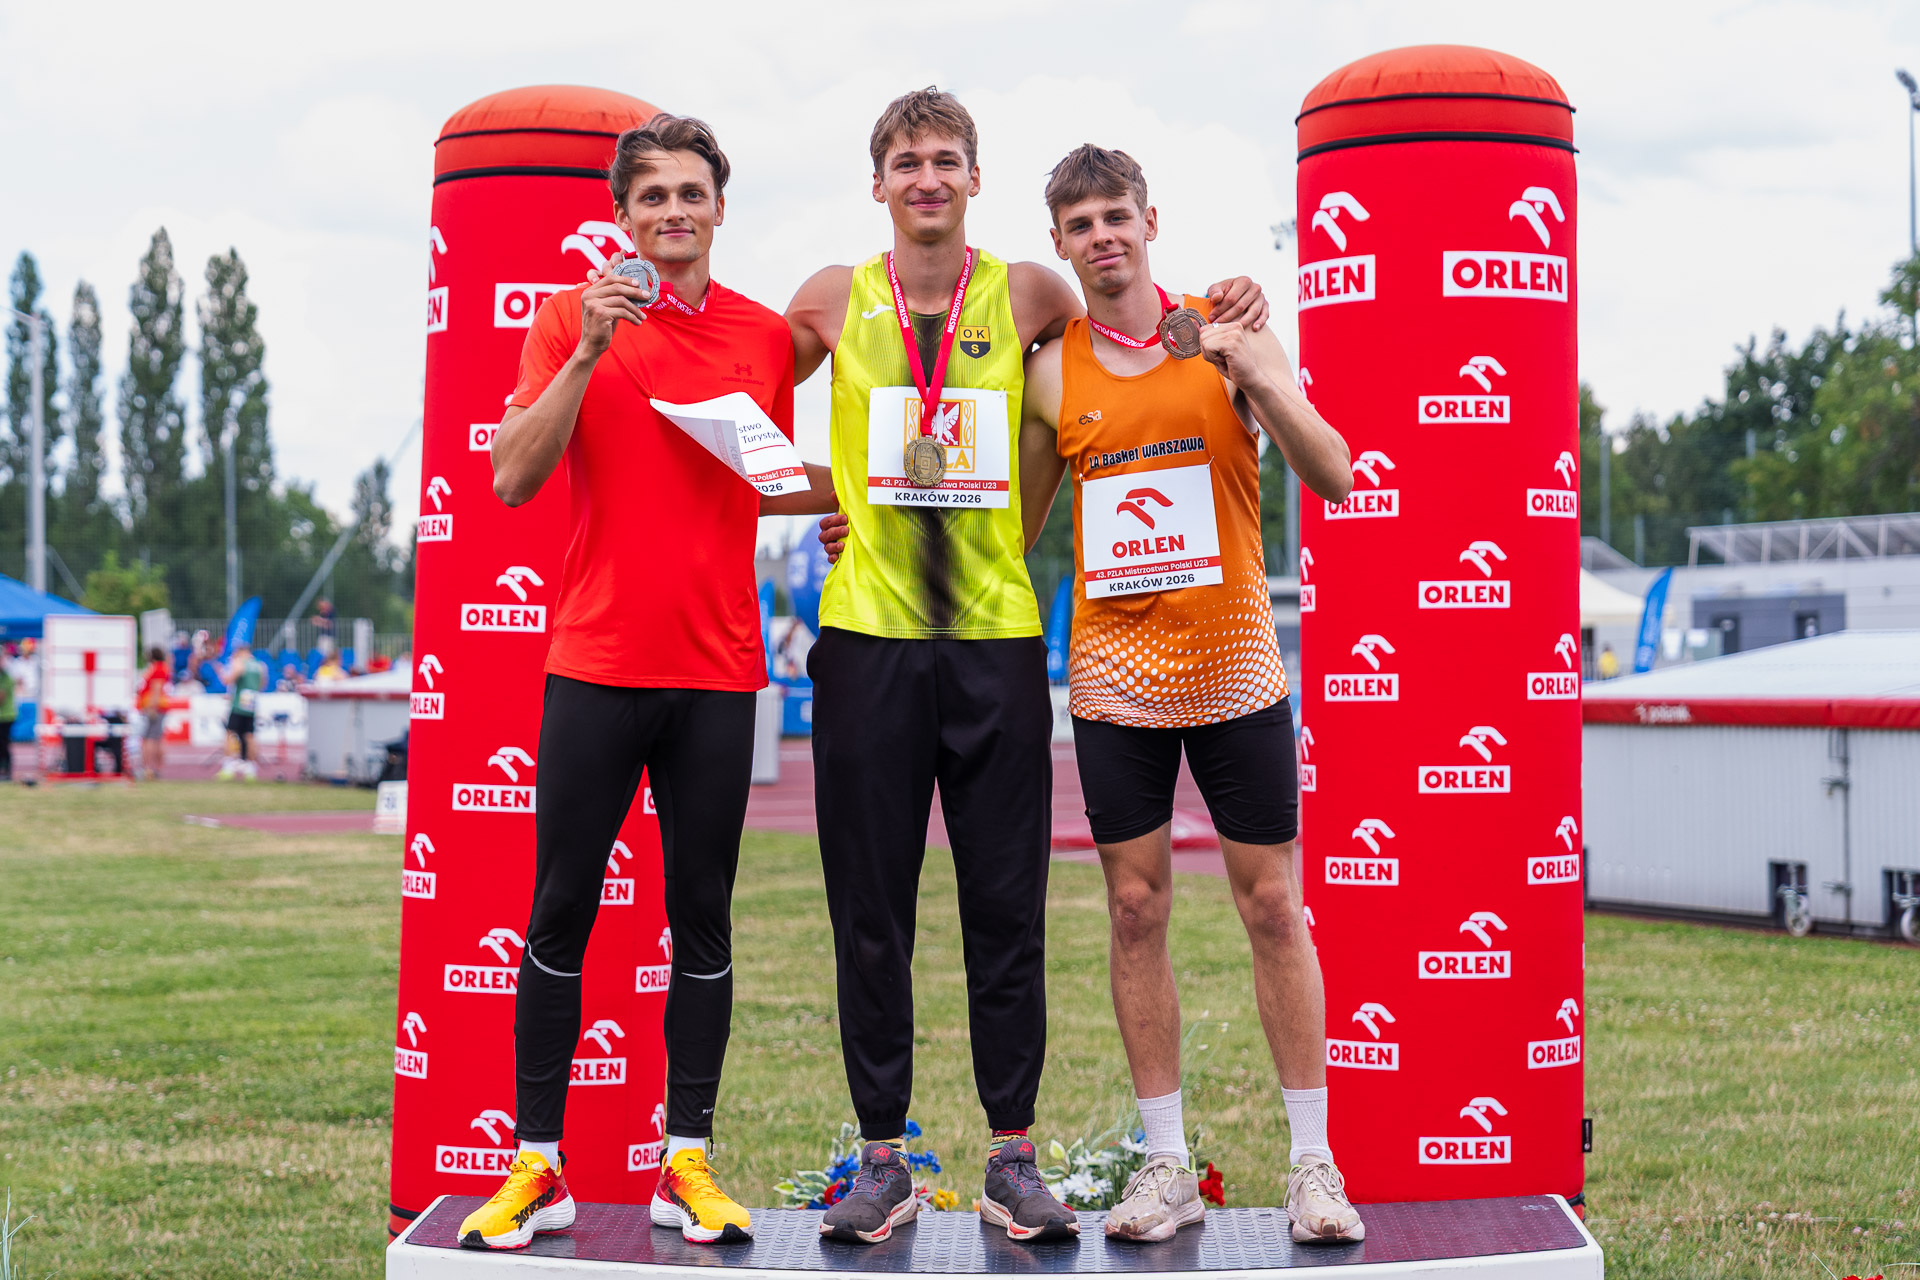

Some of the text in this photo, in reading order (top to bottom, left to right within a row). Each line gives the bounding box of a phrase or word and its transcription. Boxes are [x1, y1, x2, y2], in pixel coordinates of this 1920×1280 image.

[1451, 258, 1563, 294] ORLEN
[893, 283, 910, 329] MISTRZOSTWA
[947, 289, 965, 334] MISTRZOSTWA
[959, 266, 970, 289] POLSKI
[1424, 400, 1504, 418] ORLEN
[1089, 436, 1205, 469] LA Basket WARSZAWA
[757, 471, 780, 482] Polski
[780, 468, 795, 479] U23
[881, 478, 893, 487] 43.
[893, 479, 911, 487] PZLA
[959, 481, 981, 489] Polski
[982, 482, 997, 490] U23
[895, 491, 982, 504] KRAKÓW 2026
[1329, 494, 1393, 515] ORLEN
[1531, 493, 1575, 513] ORLEN
[1111, 534, 1186, 559] ORLEN
[1095, 558, 1209, 579] 43. PZLA Mistrzostwa Polski U23
[1109, 573, 1195, 592] KRAKÓW 2026
[1424, 585, 1504, 604] ORLEN
[466, 608, 539, 628] ORLEN
[1328, 678, 1392, 696] ORLEN
[1531, 677, 1576, 696] ORLEN
[1424, 770, 1504, 788] ORLEN
[457, 788, 531, 808] ORLEN
[1329, 861, 1393, 881] ORLEN
[1531, 859, 1577, 880] ORLEN
[1424, 955, 1505, 975] ORLEN
[1328, 1043, 1393, 1066] ORLEN
[1531, 1040, 1578, 1064] ORLEN
[570, 1062, 622, 1082] RLEN
[440, 1150, 514, 1171] ORLEN
[632, 1146, 662, 1169] ORLE
[1424, 1141, 1505, 1160] ORLEN
